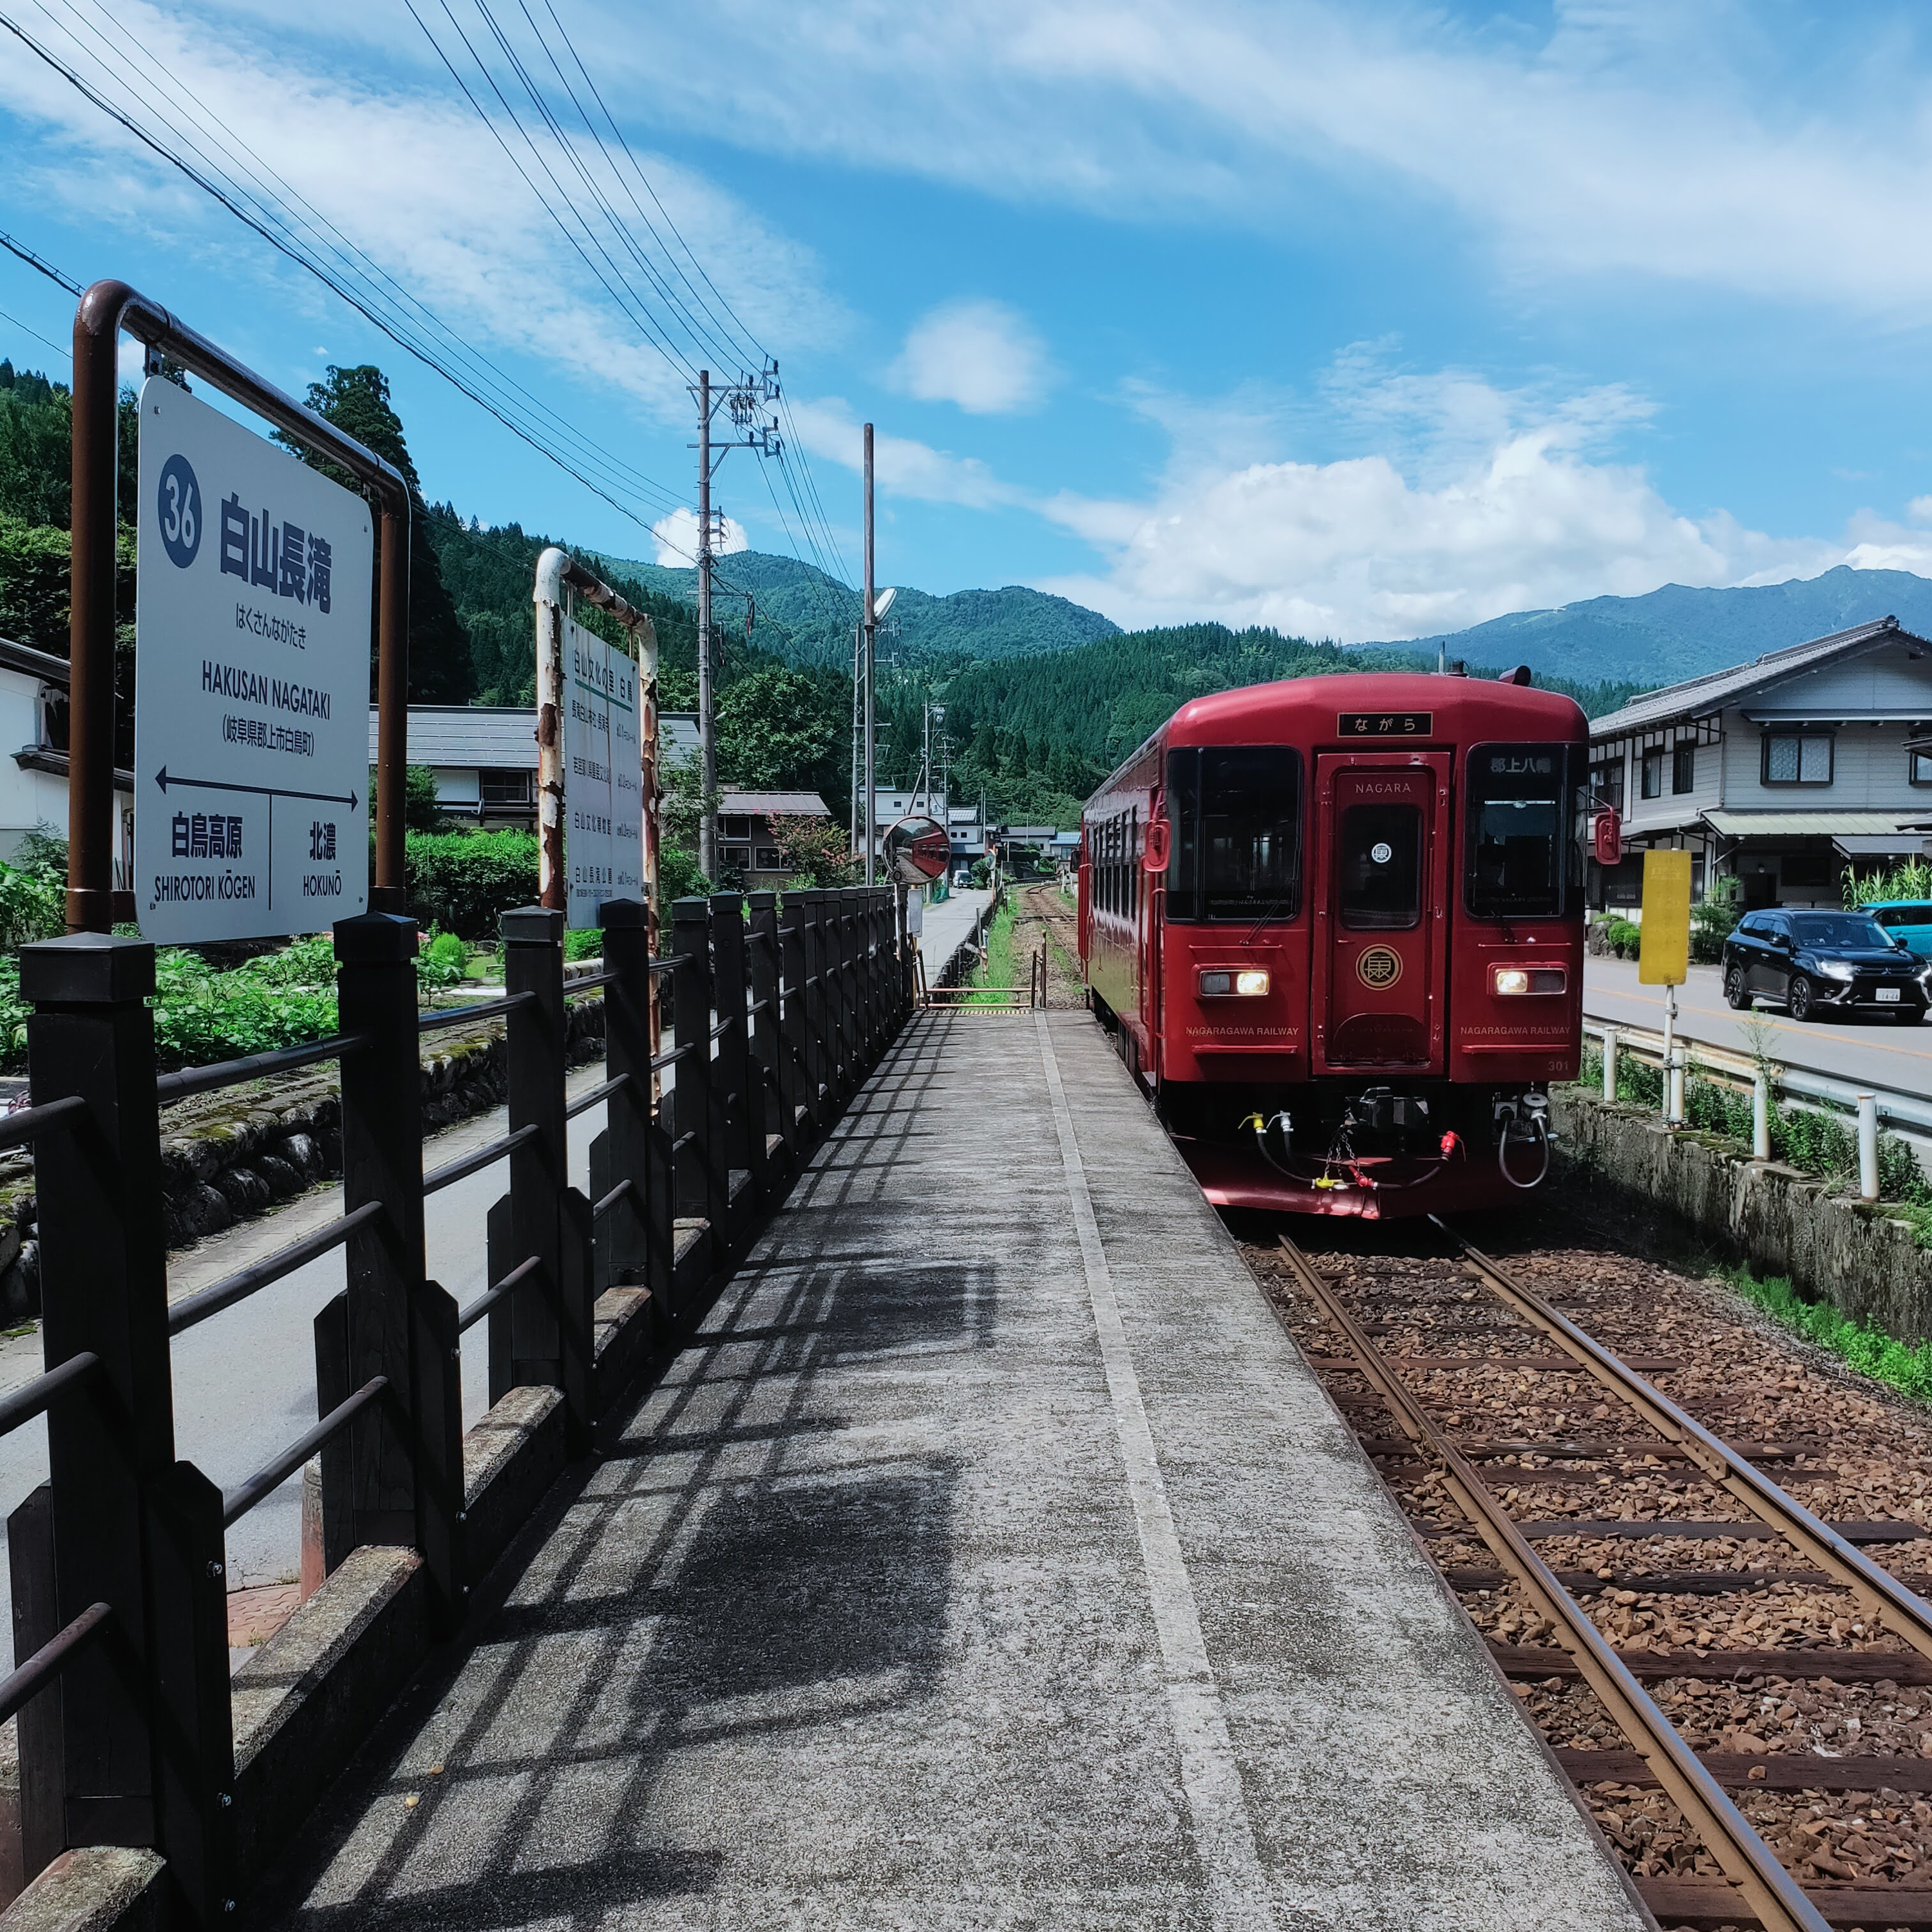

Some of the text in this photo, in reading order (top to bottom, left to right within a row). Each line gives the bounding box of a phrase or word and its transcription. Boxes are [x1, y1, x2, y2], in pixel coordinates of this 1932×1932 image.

[164, 474, 195, 549] 36
[220, 492, 332, 614] 白山長滝
[236, 602, 306, 650] はくさんながたき
[574, 647, 614, 693] 白山文化の里
[202, 659, 330, 720] HAKUSAN NAGATAKI
[1354, 718, 1416, 732] ながら
[1490, 757, 1551, 773] 郡上八幡
[1355, 783, 1411, 793] NAGARA
[171, 810, 243, 859] 白鳥高原
[309, 821, 337, 861] 北濃
[155, 869, 255, 902] SHIROTORI KŌGEN
[303, 869, 341, 896] HOKUNŌ
[1186, 1027, 1298, 1036] NAGARAGAWA RAILWAY
[1461, 1027, 1570, 1035] NAGARAGAWA RAILWAY
[1548, 1061, 1569, 1071] 301
